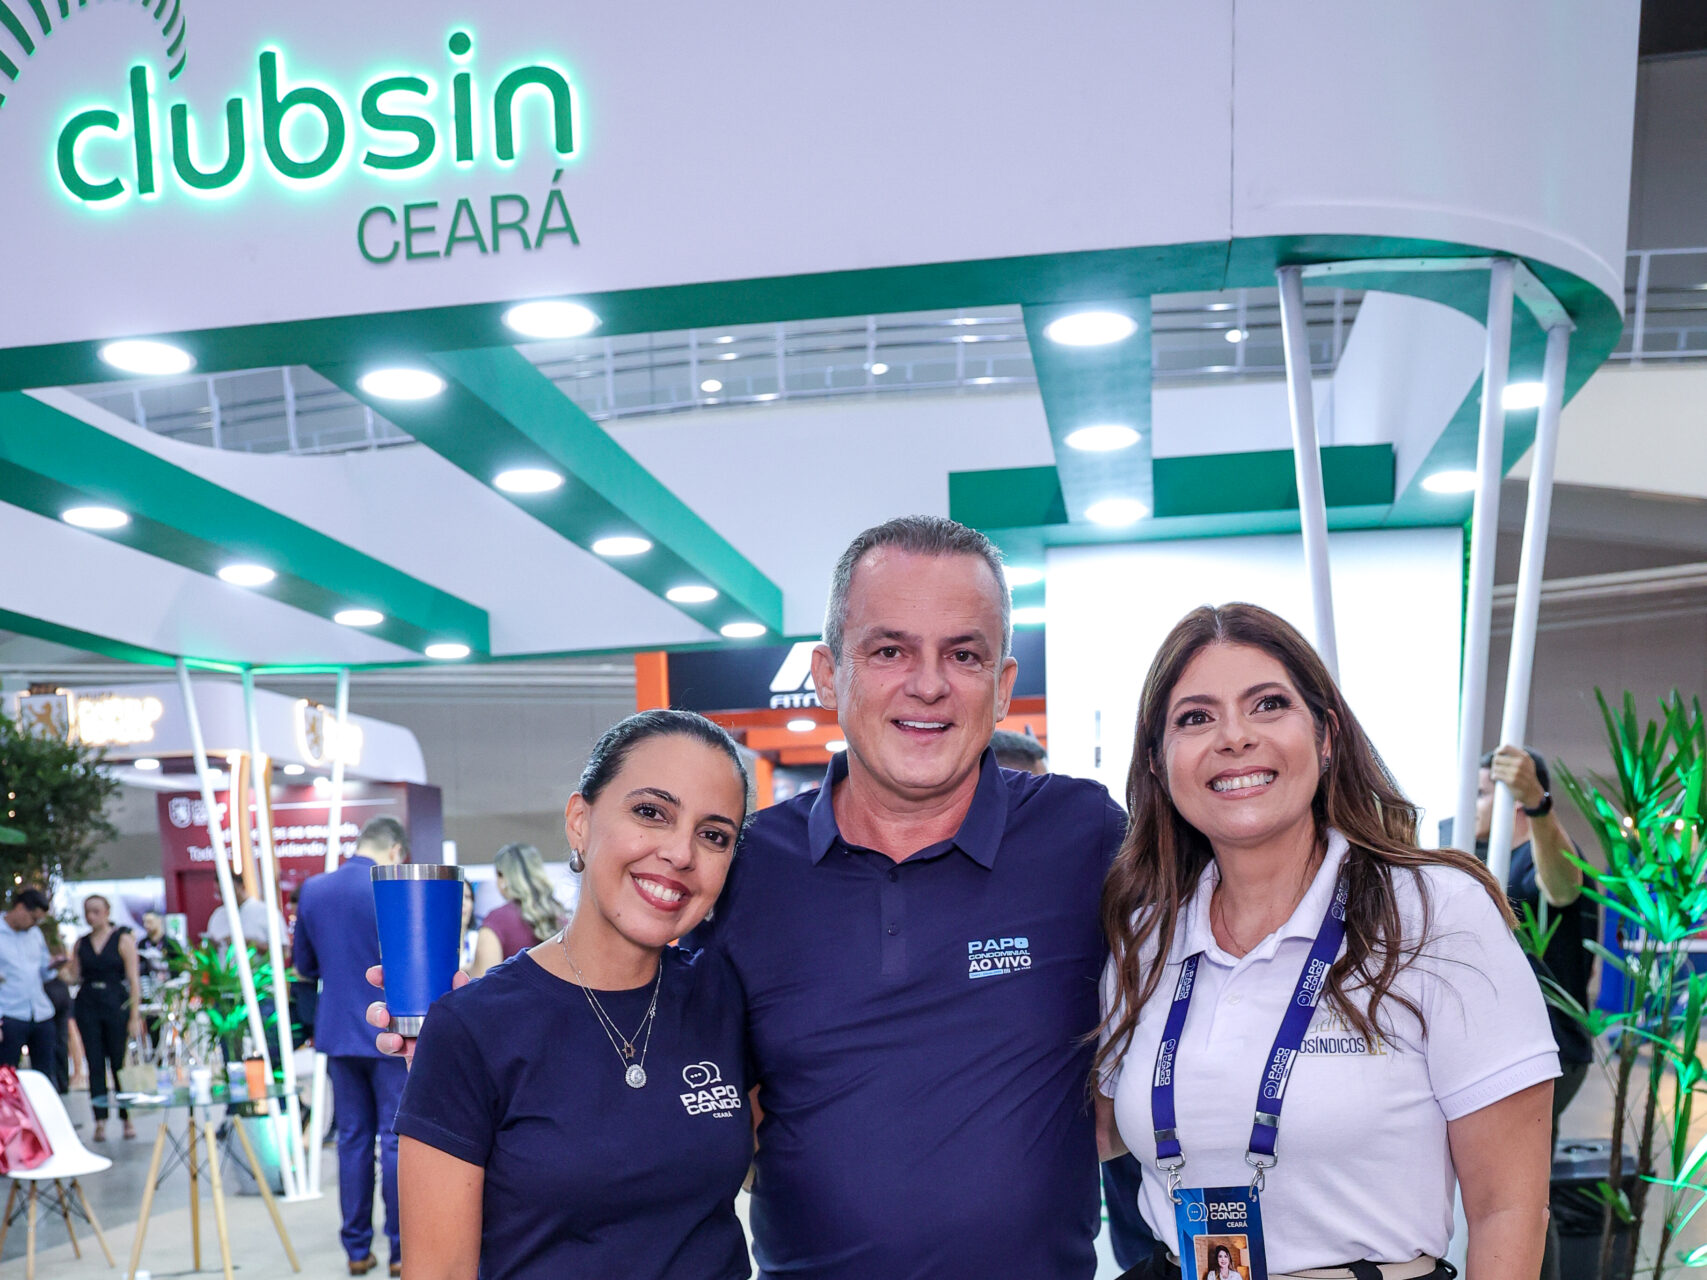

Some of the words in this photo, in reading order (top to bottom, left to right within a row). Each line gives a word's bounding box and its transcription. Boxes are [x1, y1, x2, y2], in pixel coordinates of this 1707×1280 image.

[56, 31, 575, 201] clubsin
[357, 169, 580, 265] CEARÁ
[968, 937, 1029, 954] PAPO
[969, 949, 1030, 960] CONDOMINIAL
[969, 958, 992, 972] AO
[993, 955, 1032, 969] VIVO
[1302, 958, 1320, 990] PAPO
[1310, 960, 1325, 991] CONDO
[1182, 970, 1195, 1000] PAPO
[1164, 1053, 1173, 1086] PAPO
[1268, 1047, 1285, 1080] PAPO
[1275, 1048, 1291, 1081] CONDO
[680, 1085, 739, 1106] PAPO
[686, 1098, 741, 1116] CONDO
[1209, 1202, 1247, 1212] PAPO
[1210, 1211, 1248, 1220] CONDO
[1226, 1220, 1248, 1228] CEARÁ
